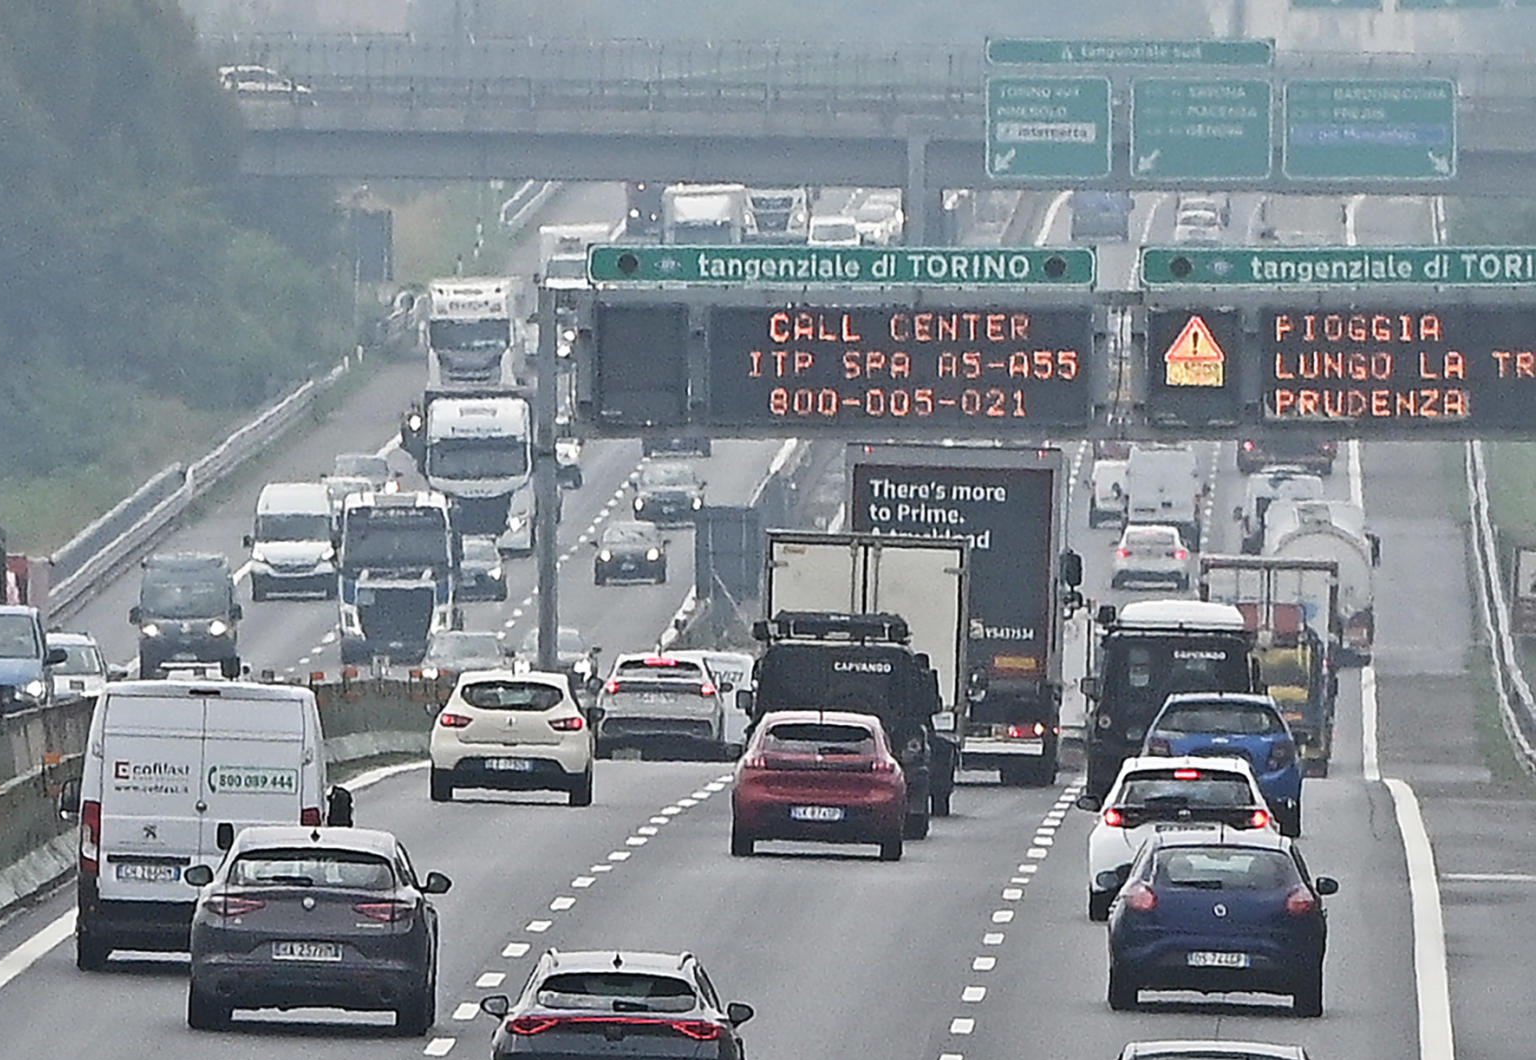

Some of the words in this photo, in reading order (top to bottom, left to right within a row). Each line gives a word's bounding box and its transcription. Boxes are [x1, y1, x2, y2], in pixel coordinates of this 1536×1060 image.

[698, 253, 861, 281] tangenziale
[871, 255, 896, 278] di
[907, 255, 1031, 280] TORINO
[1250, 254, 1413, 282] tangenziale
[1424, 255, 1449, 279] di
[768, 312, 861, 343] CALL
[889, 313, 1031, 342] CENTER
[748, 350, 815, 378] ITP
[841, 350, 912, 379] SPA
[937, 350, 1079, 380] A5-A55
[1274, 351, 1393, 380] LUNGO
[1419, 351, 1465, 380] LA
[768, 387, 1027, 418] 800-005-021
[1274, 388, 1466, 417] PRUDENZA
[869, 479, 946, 500] There's
[951, 485, 1007, 501] more
[869, 504, 892, 521] to
[897, 504, 965, 524] Prime.
[218, 773, 242, 788] 800
[270, 776, 293, 789] 444
